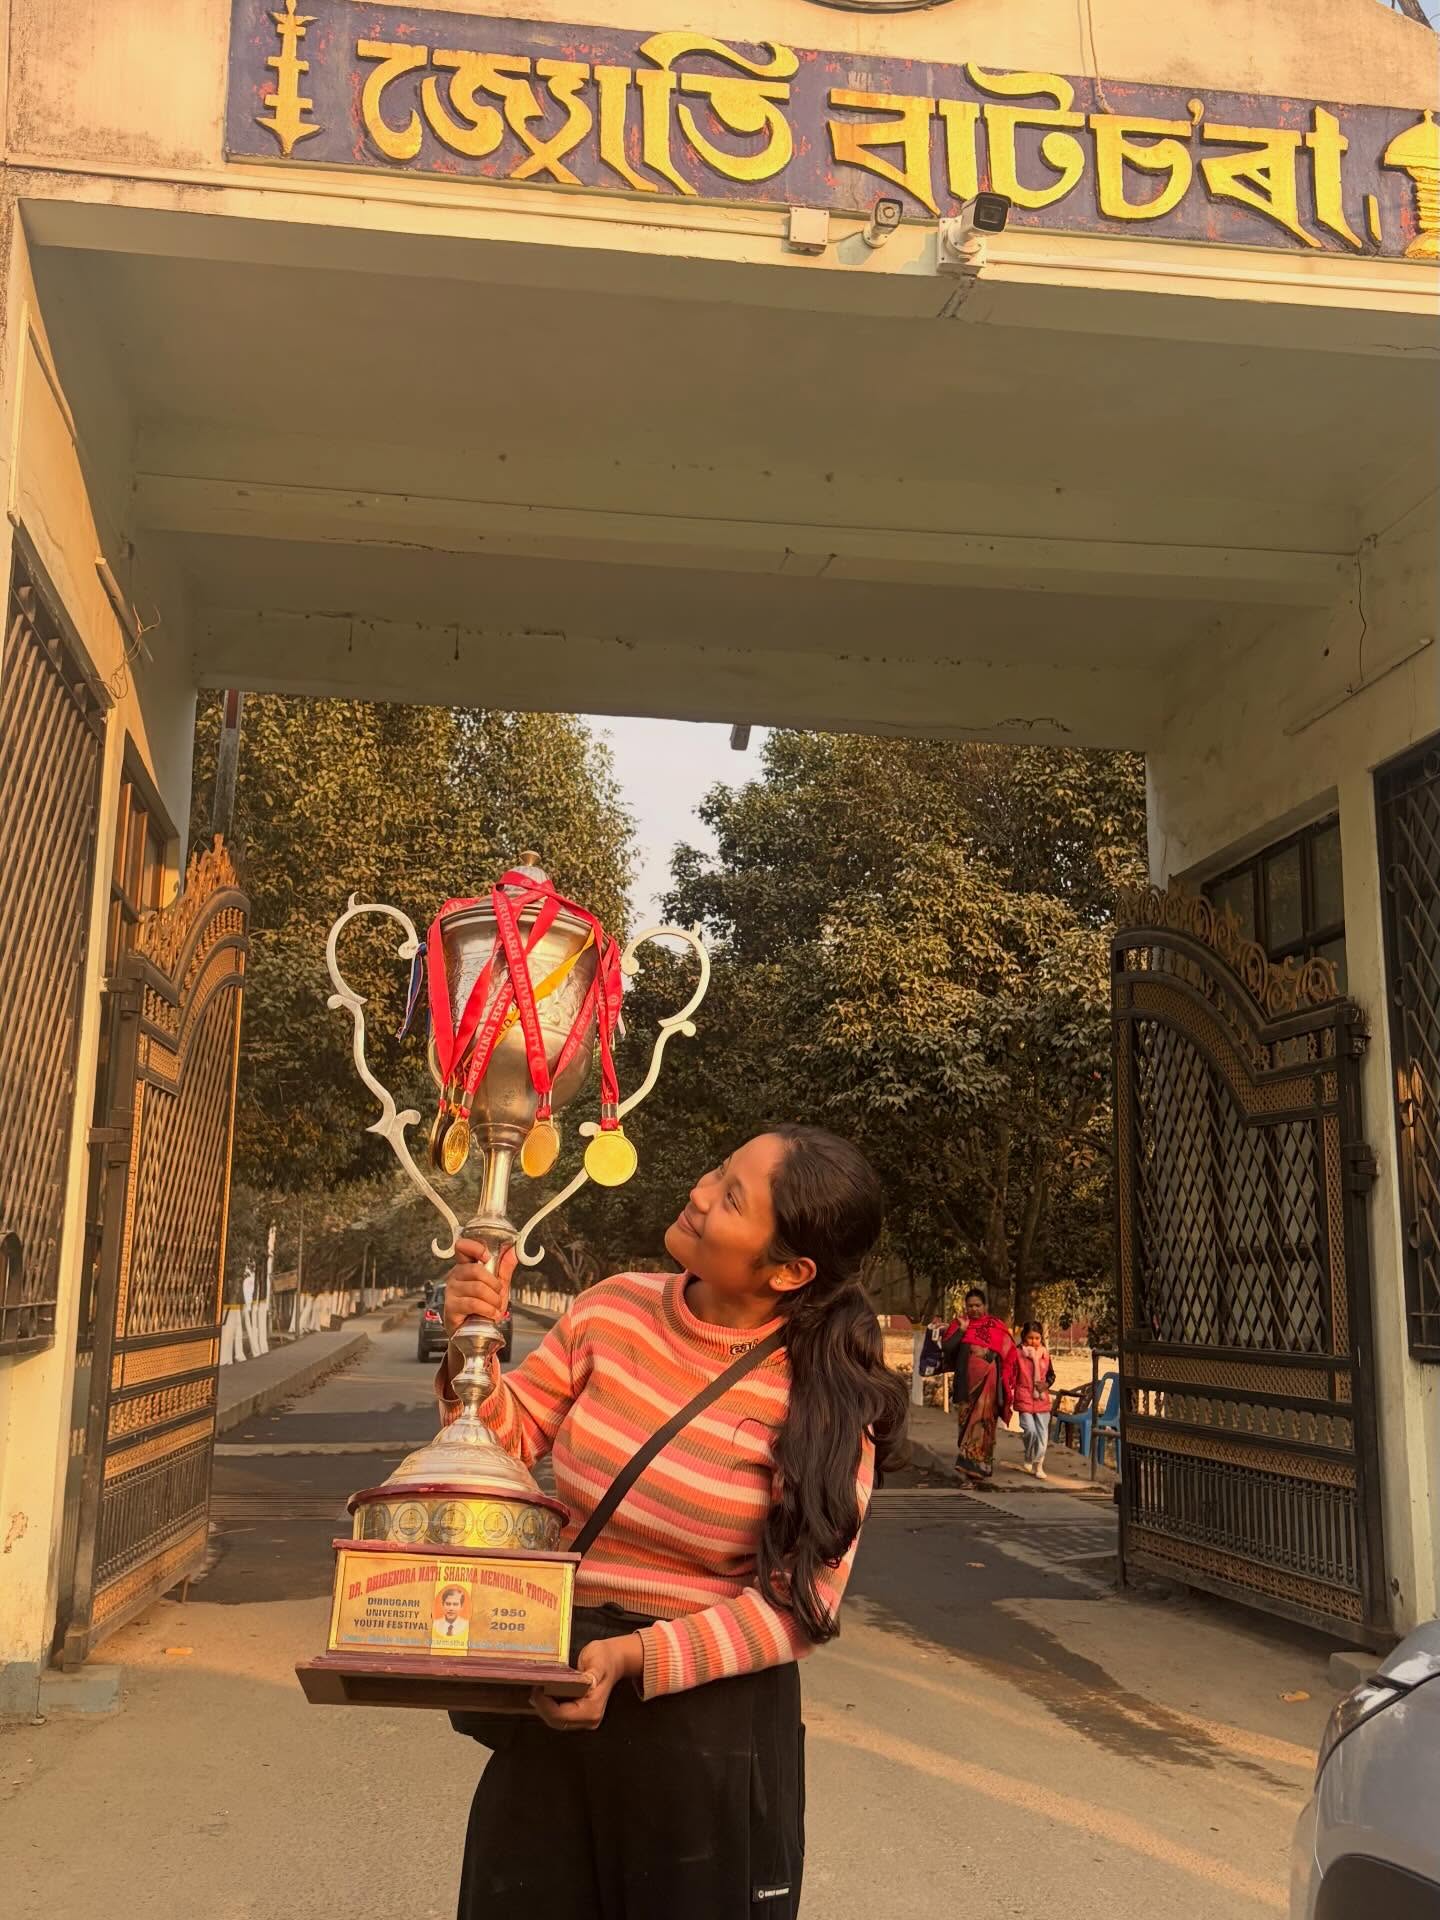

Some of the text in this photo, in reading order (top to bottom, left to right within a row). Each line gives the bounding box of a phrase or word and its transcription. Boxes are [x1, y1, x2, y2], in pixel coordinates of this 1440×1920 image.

[418, 1565, 441, 1582] NATH
[443, 1565, 478, 1584] SHARMA
[480, 1569, 524, 1596] MEMORIAL
[526, 1582, 558, 1611] TROPHY
[367, 1597, 420, 1608] DIBRUGARH
[366, 1608, 420, 1619] UNIVERSITY
[492, 1607, 527, 1618] 1950
[354, 1619, 429, 1631] YOUTH FESTIVAL
